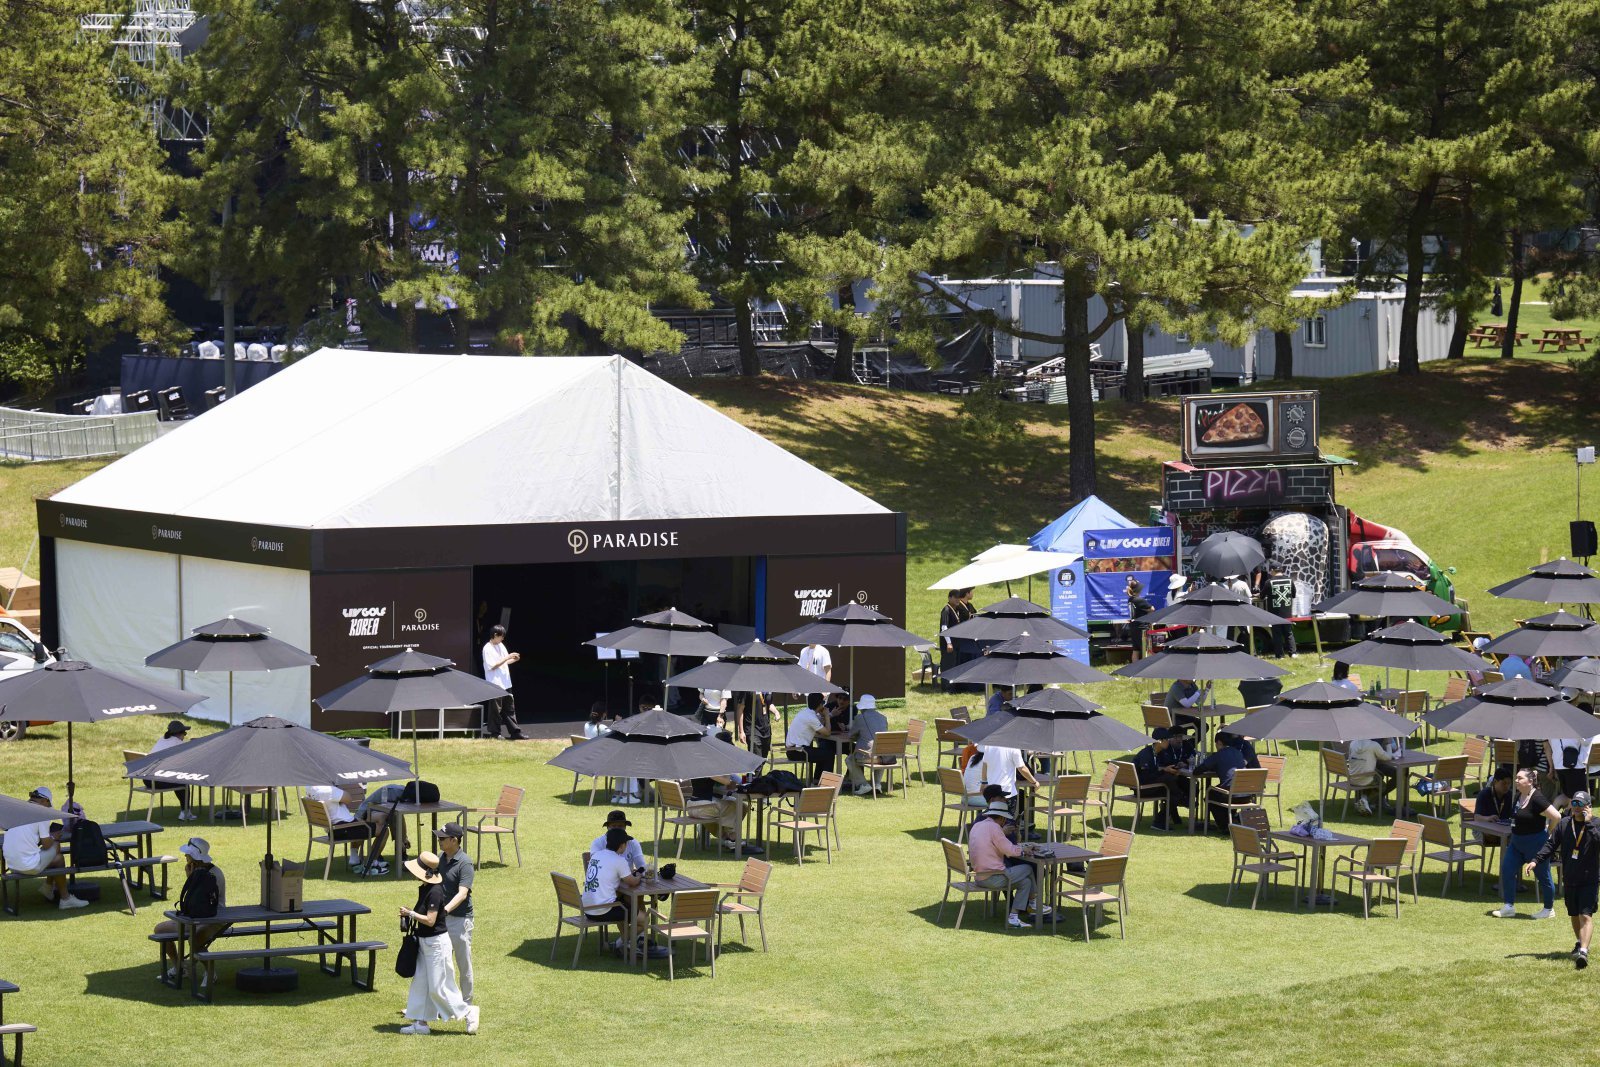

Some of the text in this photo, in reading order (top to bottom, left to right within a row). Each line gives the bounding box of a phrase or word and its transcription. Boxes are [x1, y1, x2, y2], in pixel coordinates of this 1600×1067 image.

[1207, 468, 1282, 498] PIZZA
[65, 516, 88, 528] PARADISE
[158, 528, 183, 540] PARADISE
[593, 531, 679, 549] PARADISE
[258, 540, 284, 552] PARADISE
[800, 599, 827, 616] KOREA
[349, 618, 380, 636] KOREA
[401, 623, 440, 631] PARADISE
